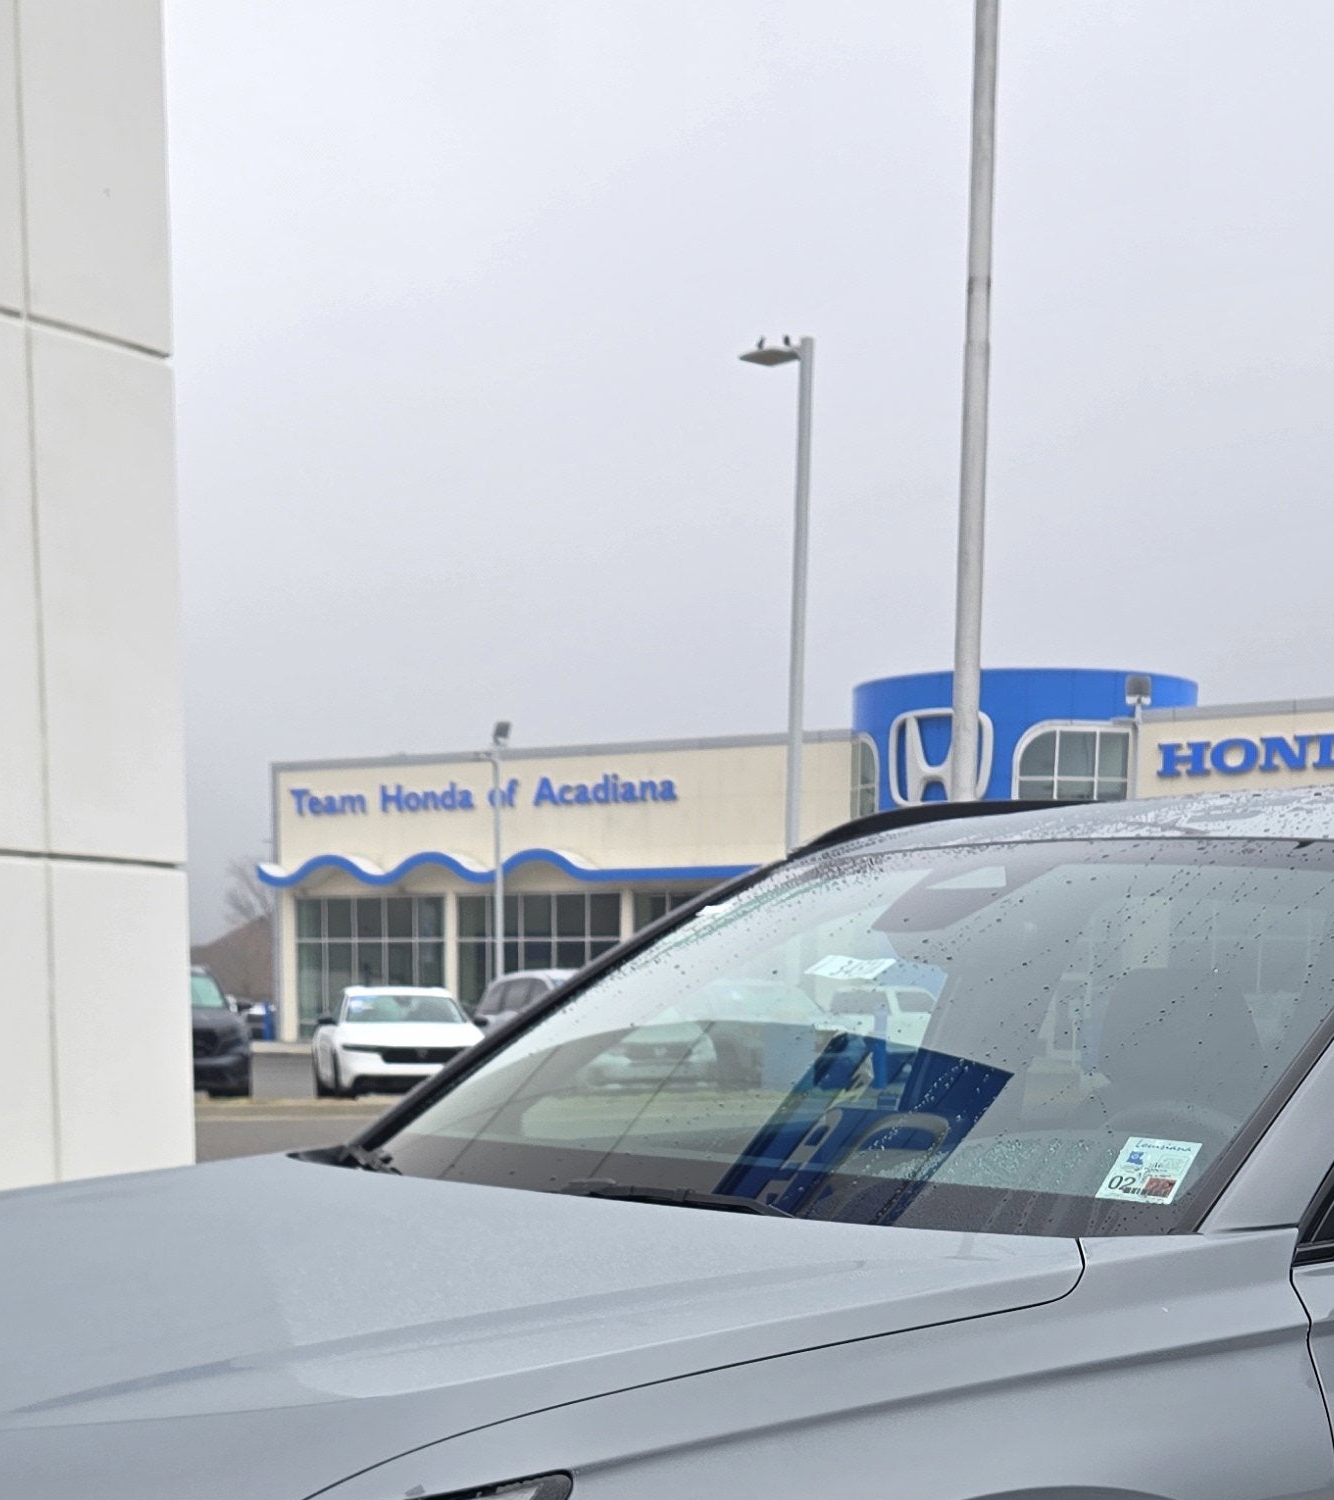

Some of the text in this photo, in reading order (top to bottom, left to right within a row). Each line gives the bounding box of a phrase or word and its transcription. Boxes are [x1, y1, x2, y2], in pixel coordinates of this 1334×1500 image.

[289, 773, 678, 815] Team Honda of Acadiana
[1108, 1175, 1137, 1190] 02
